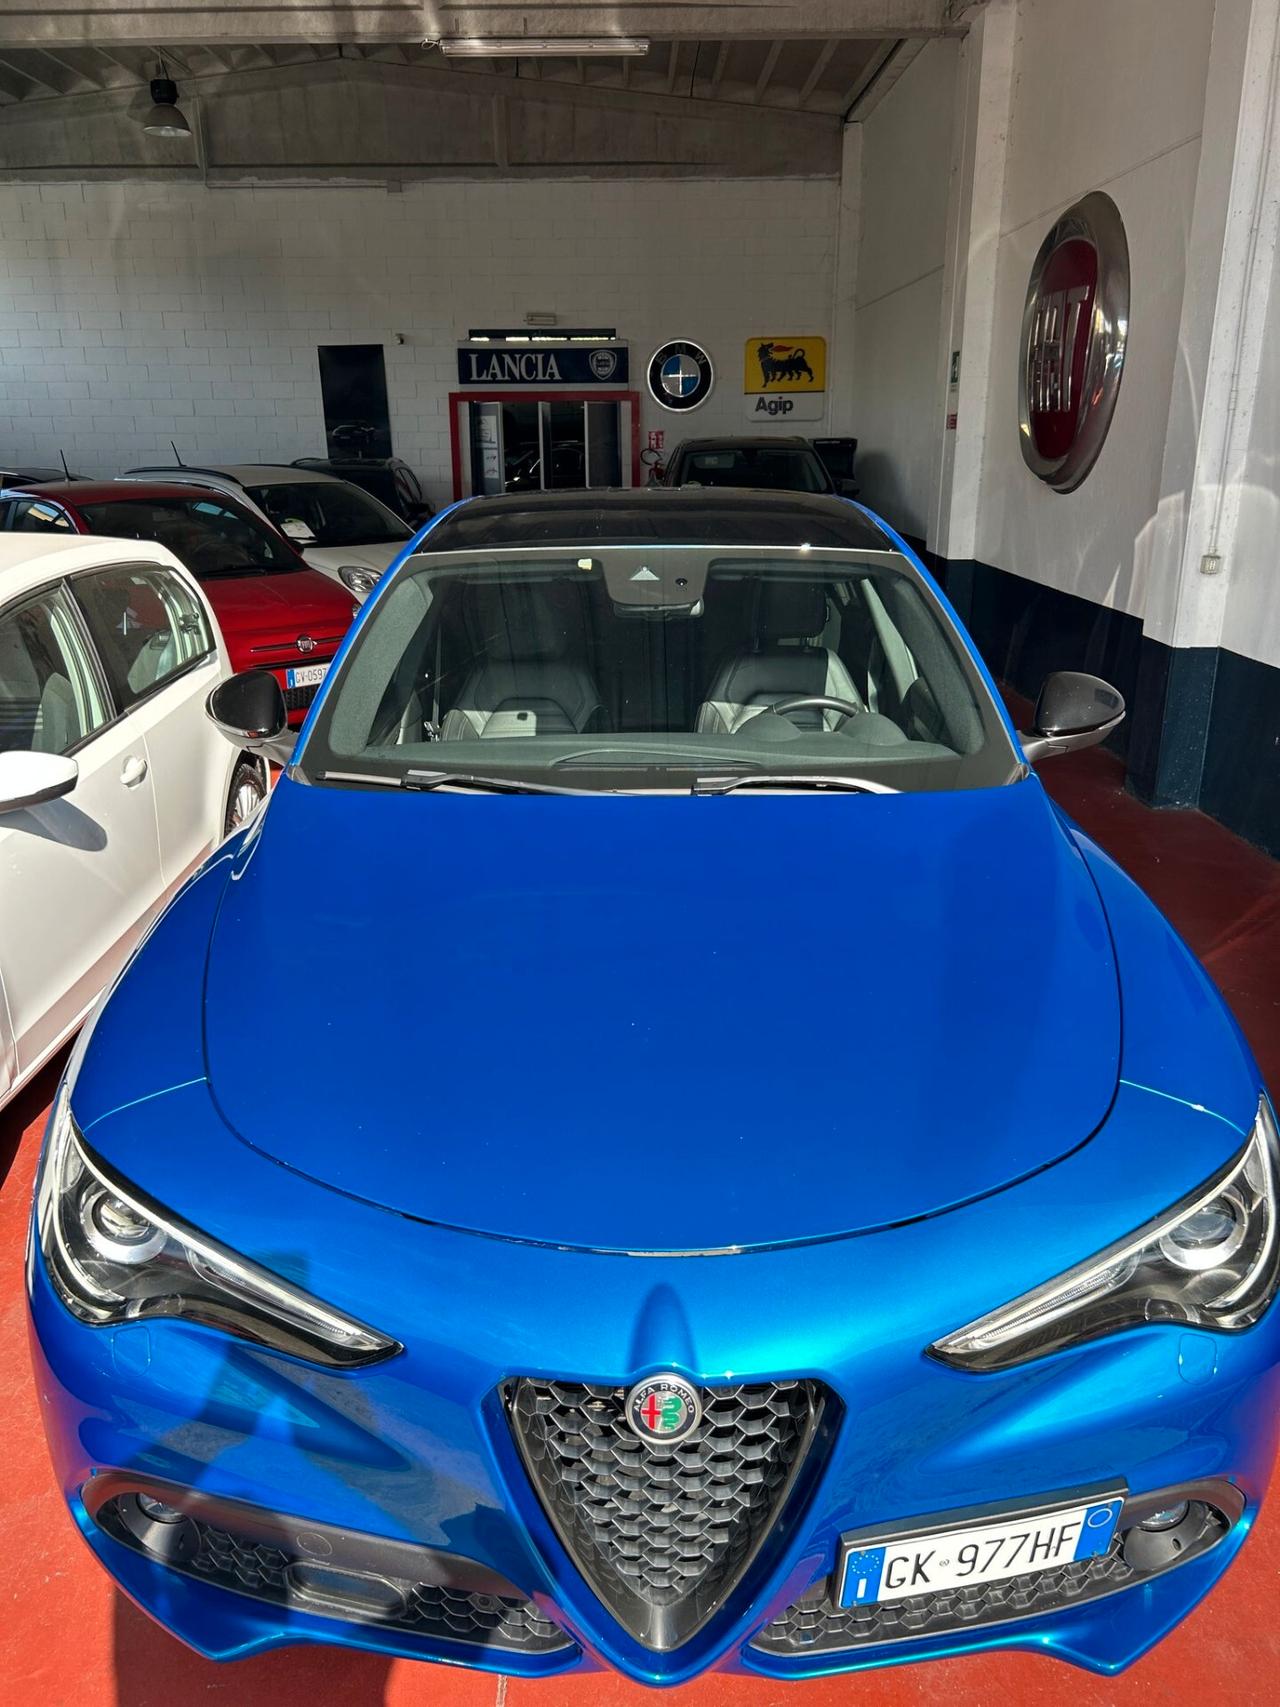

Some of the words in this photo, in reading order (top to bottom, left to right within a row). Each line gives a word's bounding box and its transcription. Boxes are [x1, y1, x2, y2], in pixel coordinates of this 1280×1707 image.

[469, 353, 562, 381] LANCIA
[655, 344, 707, 365] BMW
[755, 396, 794, 416] Agip
[633, 1387, 656, 1412] ALFA
[660, 1383, 695, 1413] ROMEO
[885, 1550, 936, 1589] GK
[955, 1520, 1081, 1577] 977HF
